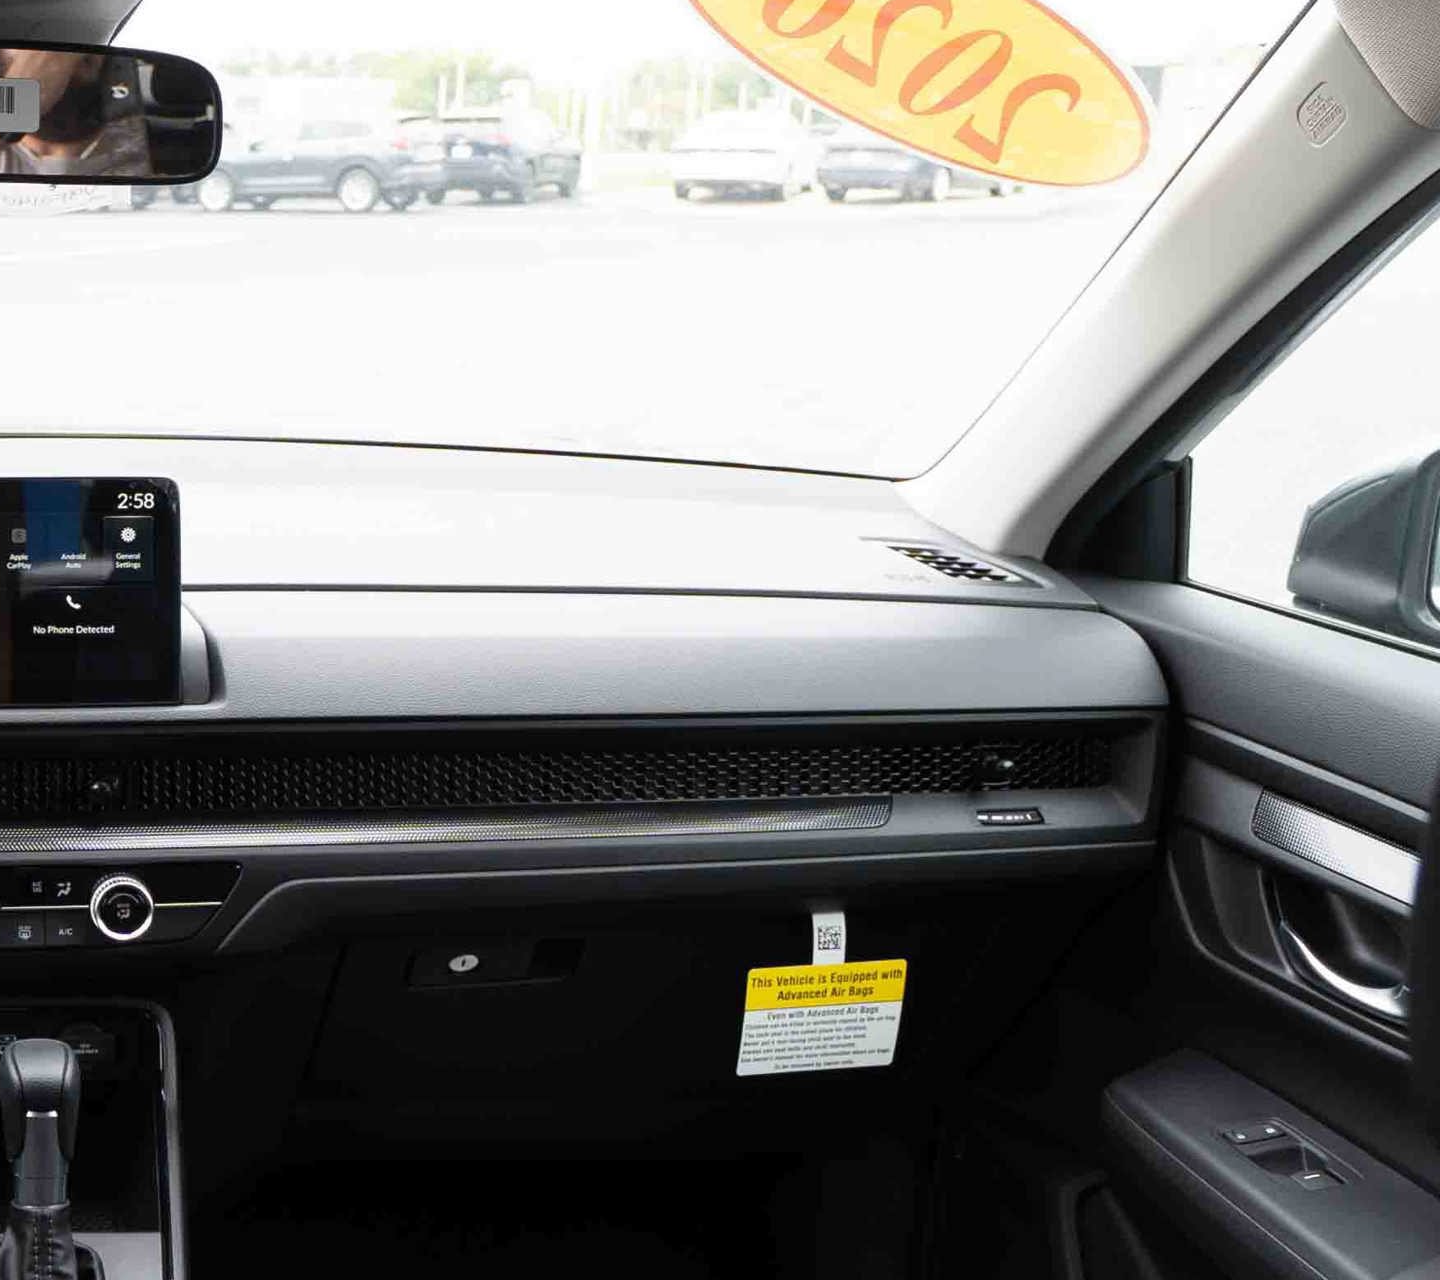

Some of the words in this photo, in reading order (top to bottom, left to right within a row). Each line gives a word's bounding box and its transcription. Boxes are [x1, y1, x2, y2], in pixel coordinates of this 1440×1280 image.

[117, 492, 154, 509] 2:58
[115, 552, 141, 560] General
[115, 561, 142, 570] Settings
[33, 624, 46, 634] No
[48, 624, 74, 634] Phone
[76, 624, 115, 635] Detected
[59, 928, 73, 936] A/C
[751, 977, 773, 989] This
[776, 973, 815, 986] Vehicle
[818, 972, 827, 984] is
[830, 969, 878, 985] Equipped
[881, 968, 903, 979] with
[777, 985, 828, 1001] Advanced
[831, 986, 846, 997] Air
[849, 984, 874, 998] Bags
[788, 1010, 805, 1019] with
[807, 1006, 845, 1018] Advanced
[846, 1006, 858, 1015] Air
[859, 1005, 879, 1016] Bags
